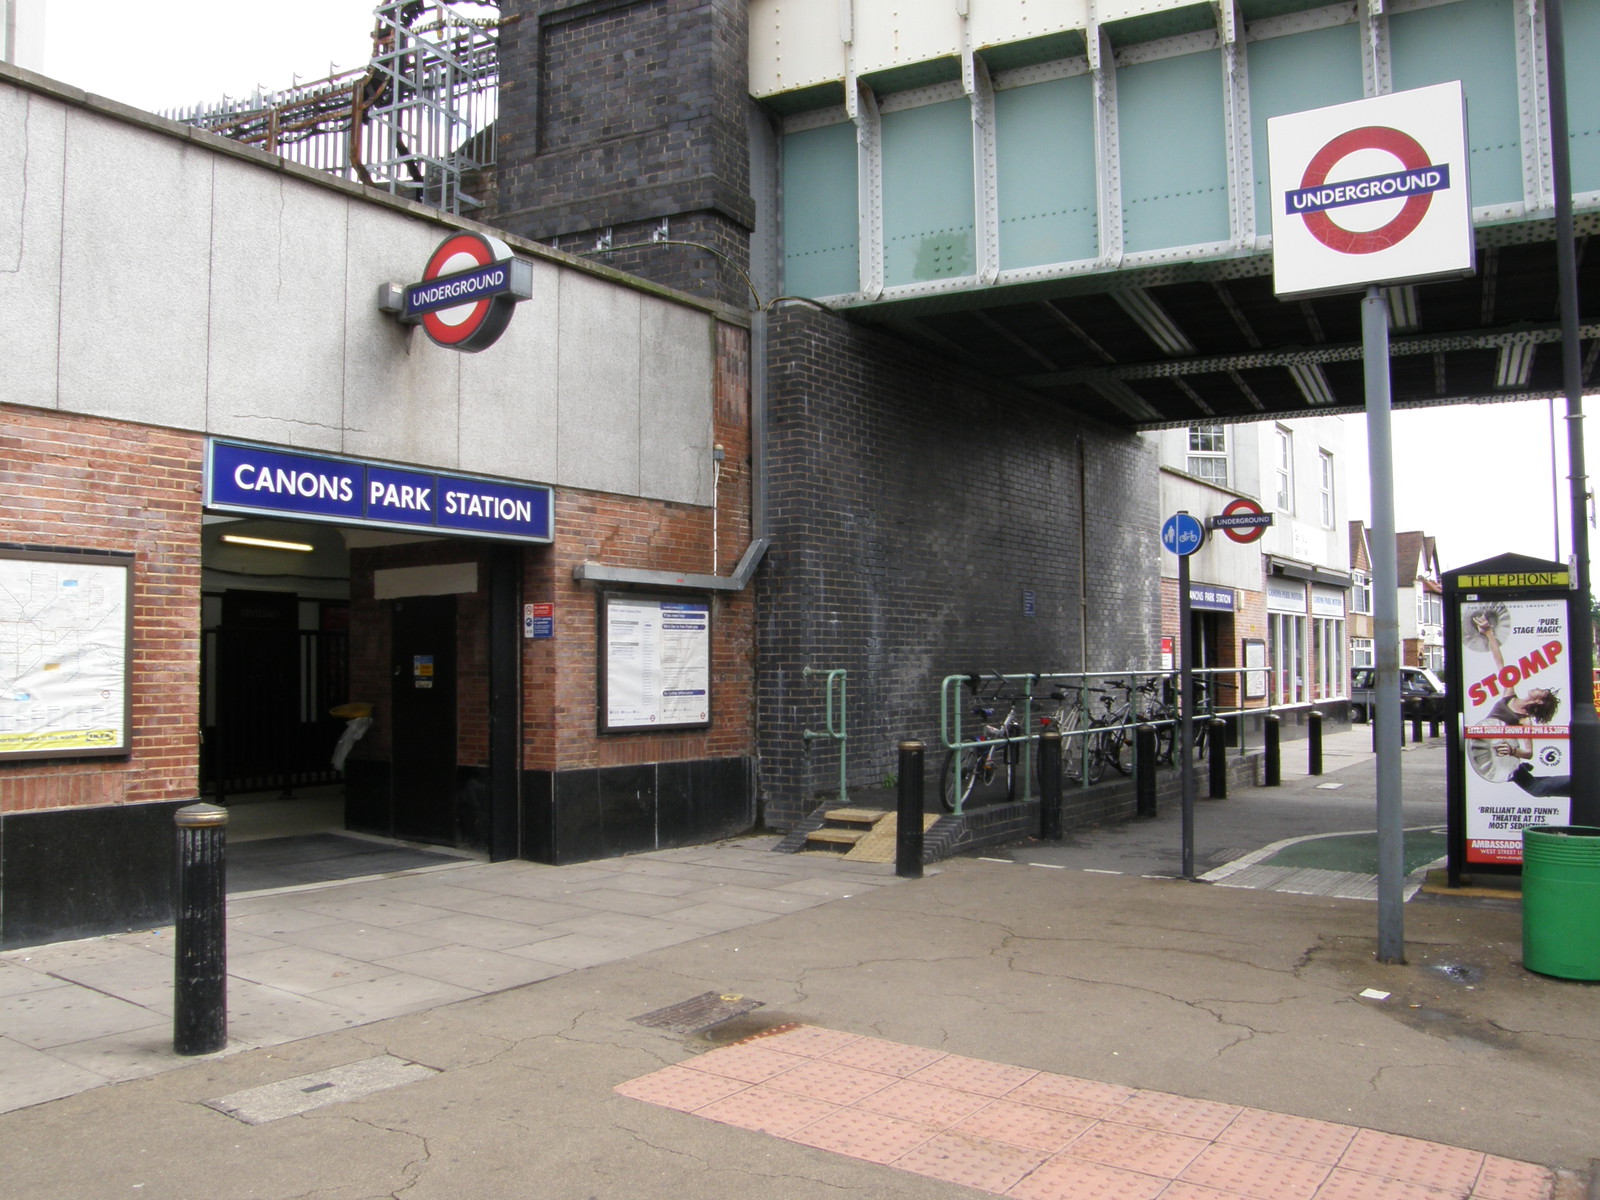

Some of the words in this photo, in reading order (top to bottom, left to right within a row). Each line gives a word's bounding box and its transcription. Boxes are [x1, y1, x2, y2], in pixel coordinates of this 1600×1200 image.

[1293, 171, 1441, 209] UNDERGROUND
[412, 270, 504, 306] UNDERGROUND
[234, 463, 353, 502] CANONS
[370, 481, 431, 512] PARK
[445, 491, 531, 522] STATION
[1216, 515, 1270, 526] UNDERGROUND
[1467, 572, 1559, 588] TELEPHONE
[1189, 590, 1204, 601] ANONS
[1204, 592, 1215, 602] PARK
[1216, 593, 1231, 604] STATION
[1513, 626, 1534, 635] STAGE
[1468, 640, 1563, 707] STOMP
[1517, 806, 1531, 814] AND
[1534, 807, 1560, 815] FUNNY:
[1492, 814, 1521, 822] THEATRE
[1471, 839, 1522, 849] AMBASSADO
